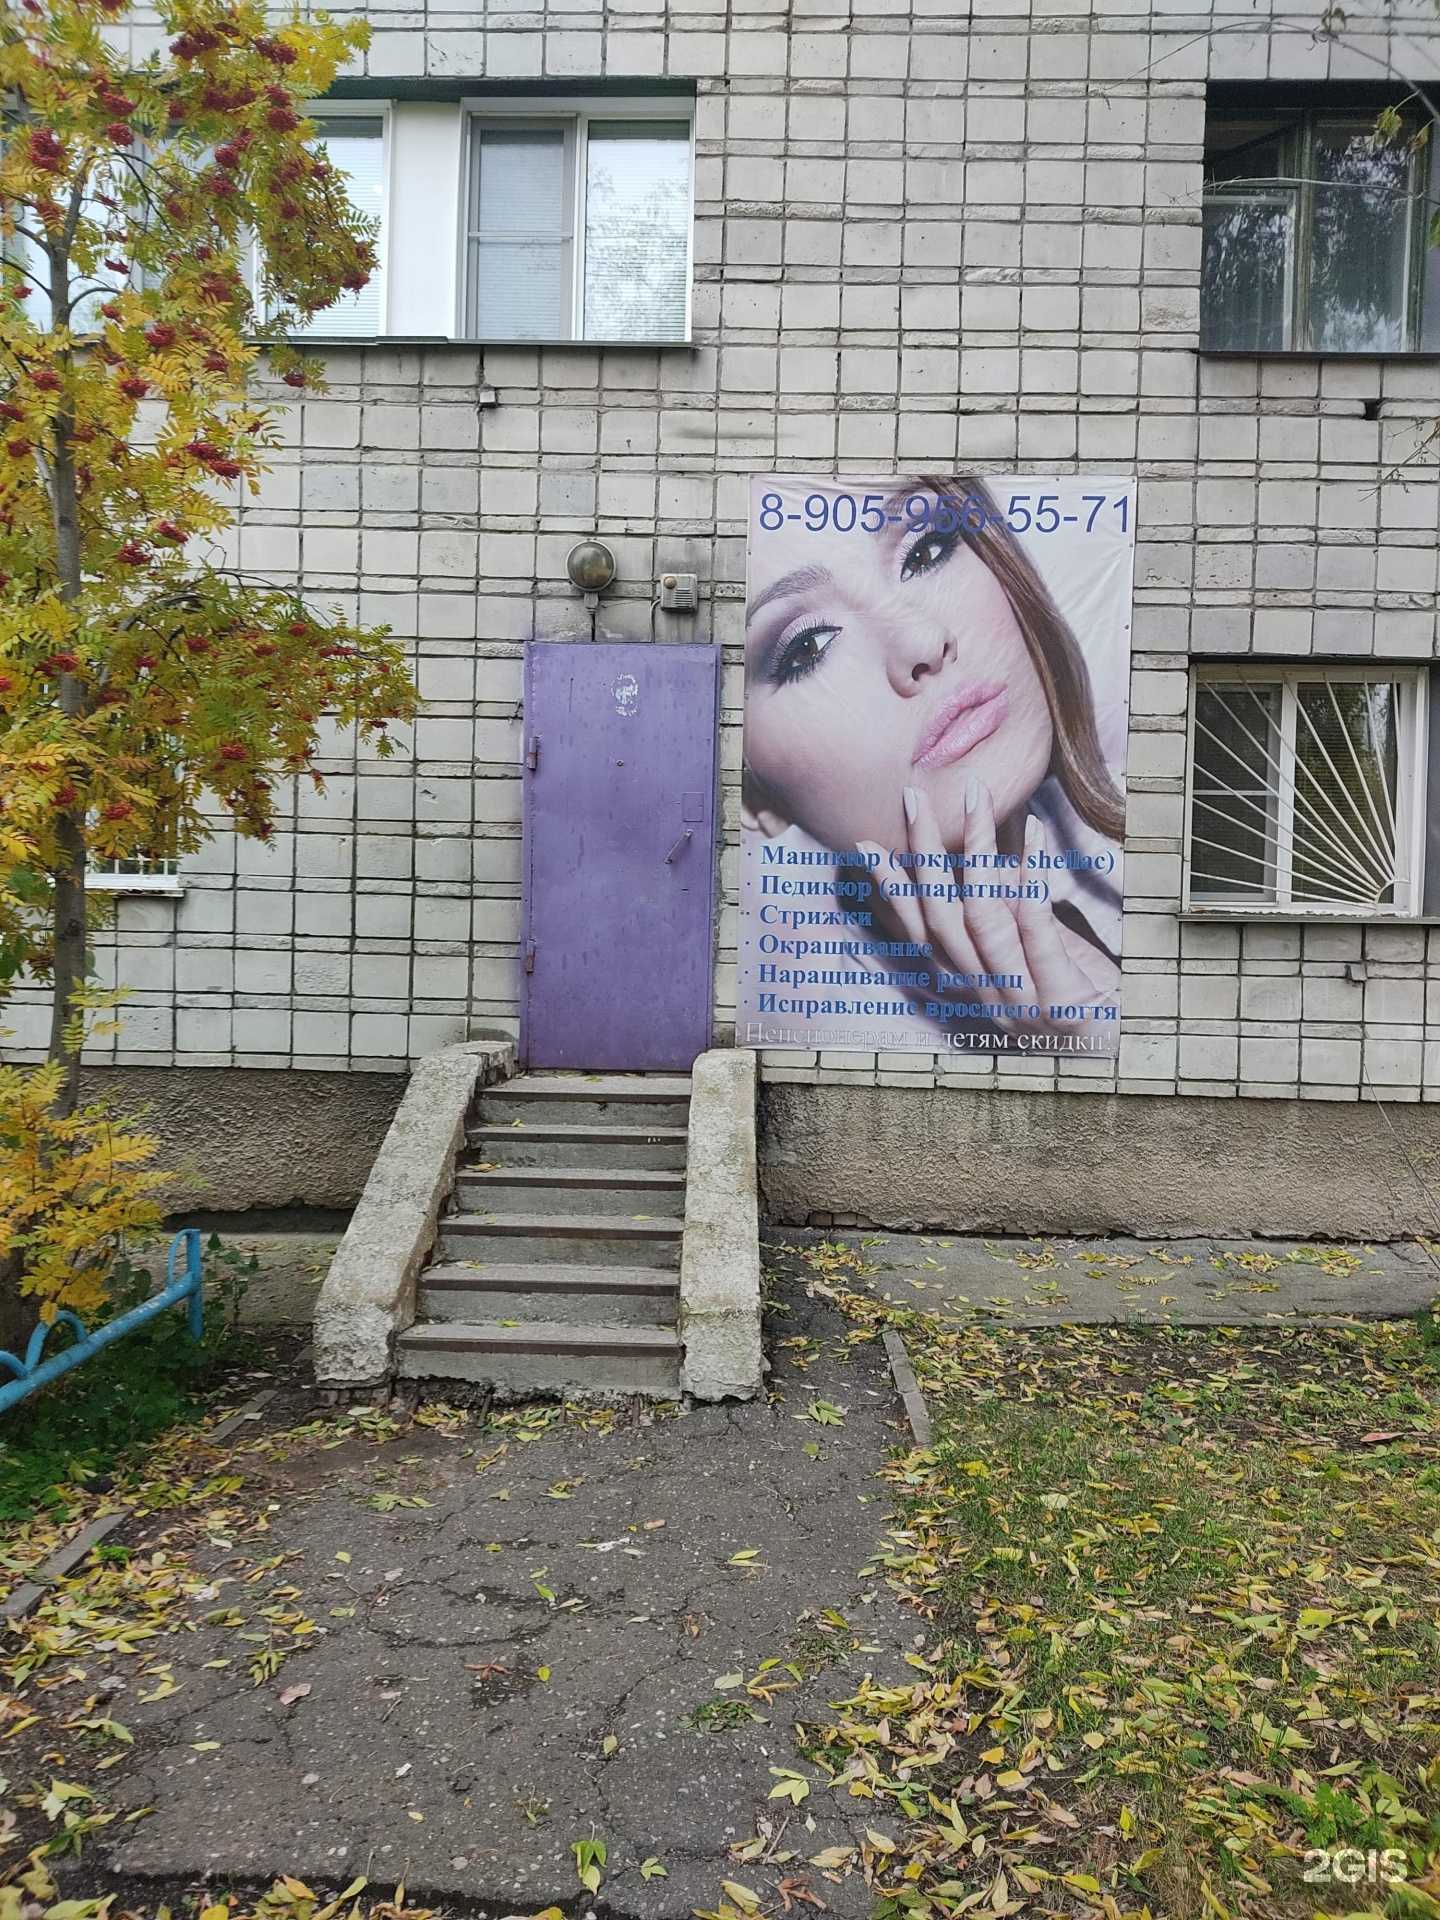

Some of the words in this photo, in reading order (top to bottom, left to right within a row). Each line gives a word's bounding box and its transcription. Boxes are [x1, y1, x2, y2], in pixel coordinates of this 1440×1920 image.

[759, 493, 1129, 533] 8-905-956-55-71
[760, 845, 881, 871] Маникюр
[888, 848, 1022, 872] (покрытие
[1027, 850, 1115, 875] shellac)
[760, 875, 872, 902] Педикюр
[879, 877, 1049, 904] (аппаратный)
[759, 904, 873, 929] Стрижки
[759, 934, 933, 960] Окрашивание
[759, 963, 930, 989] Наращивание
[936, 972, 1023, 993] ресниц
[758, 993, 917, 1019] Исправление
[925, 1002, 1040, 1023] вросшего
[1049, 1004, 1117, 1021] ногтя
